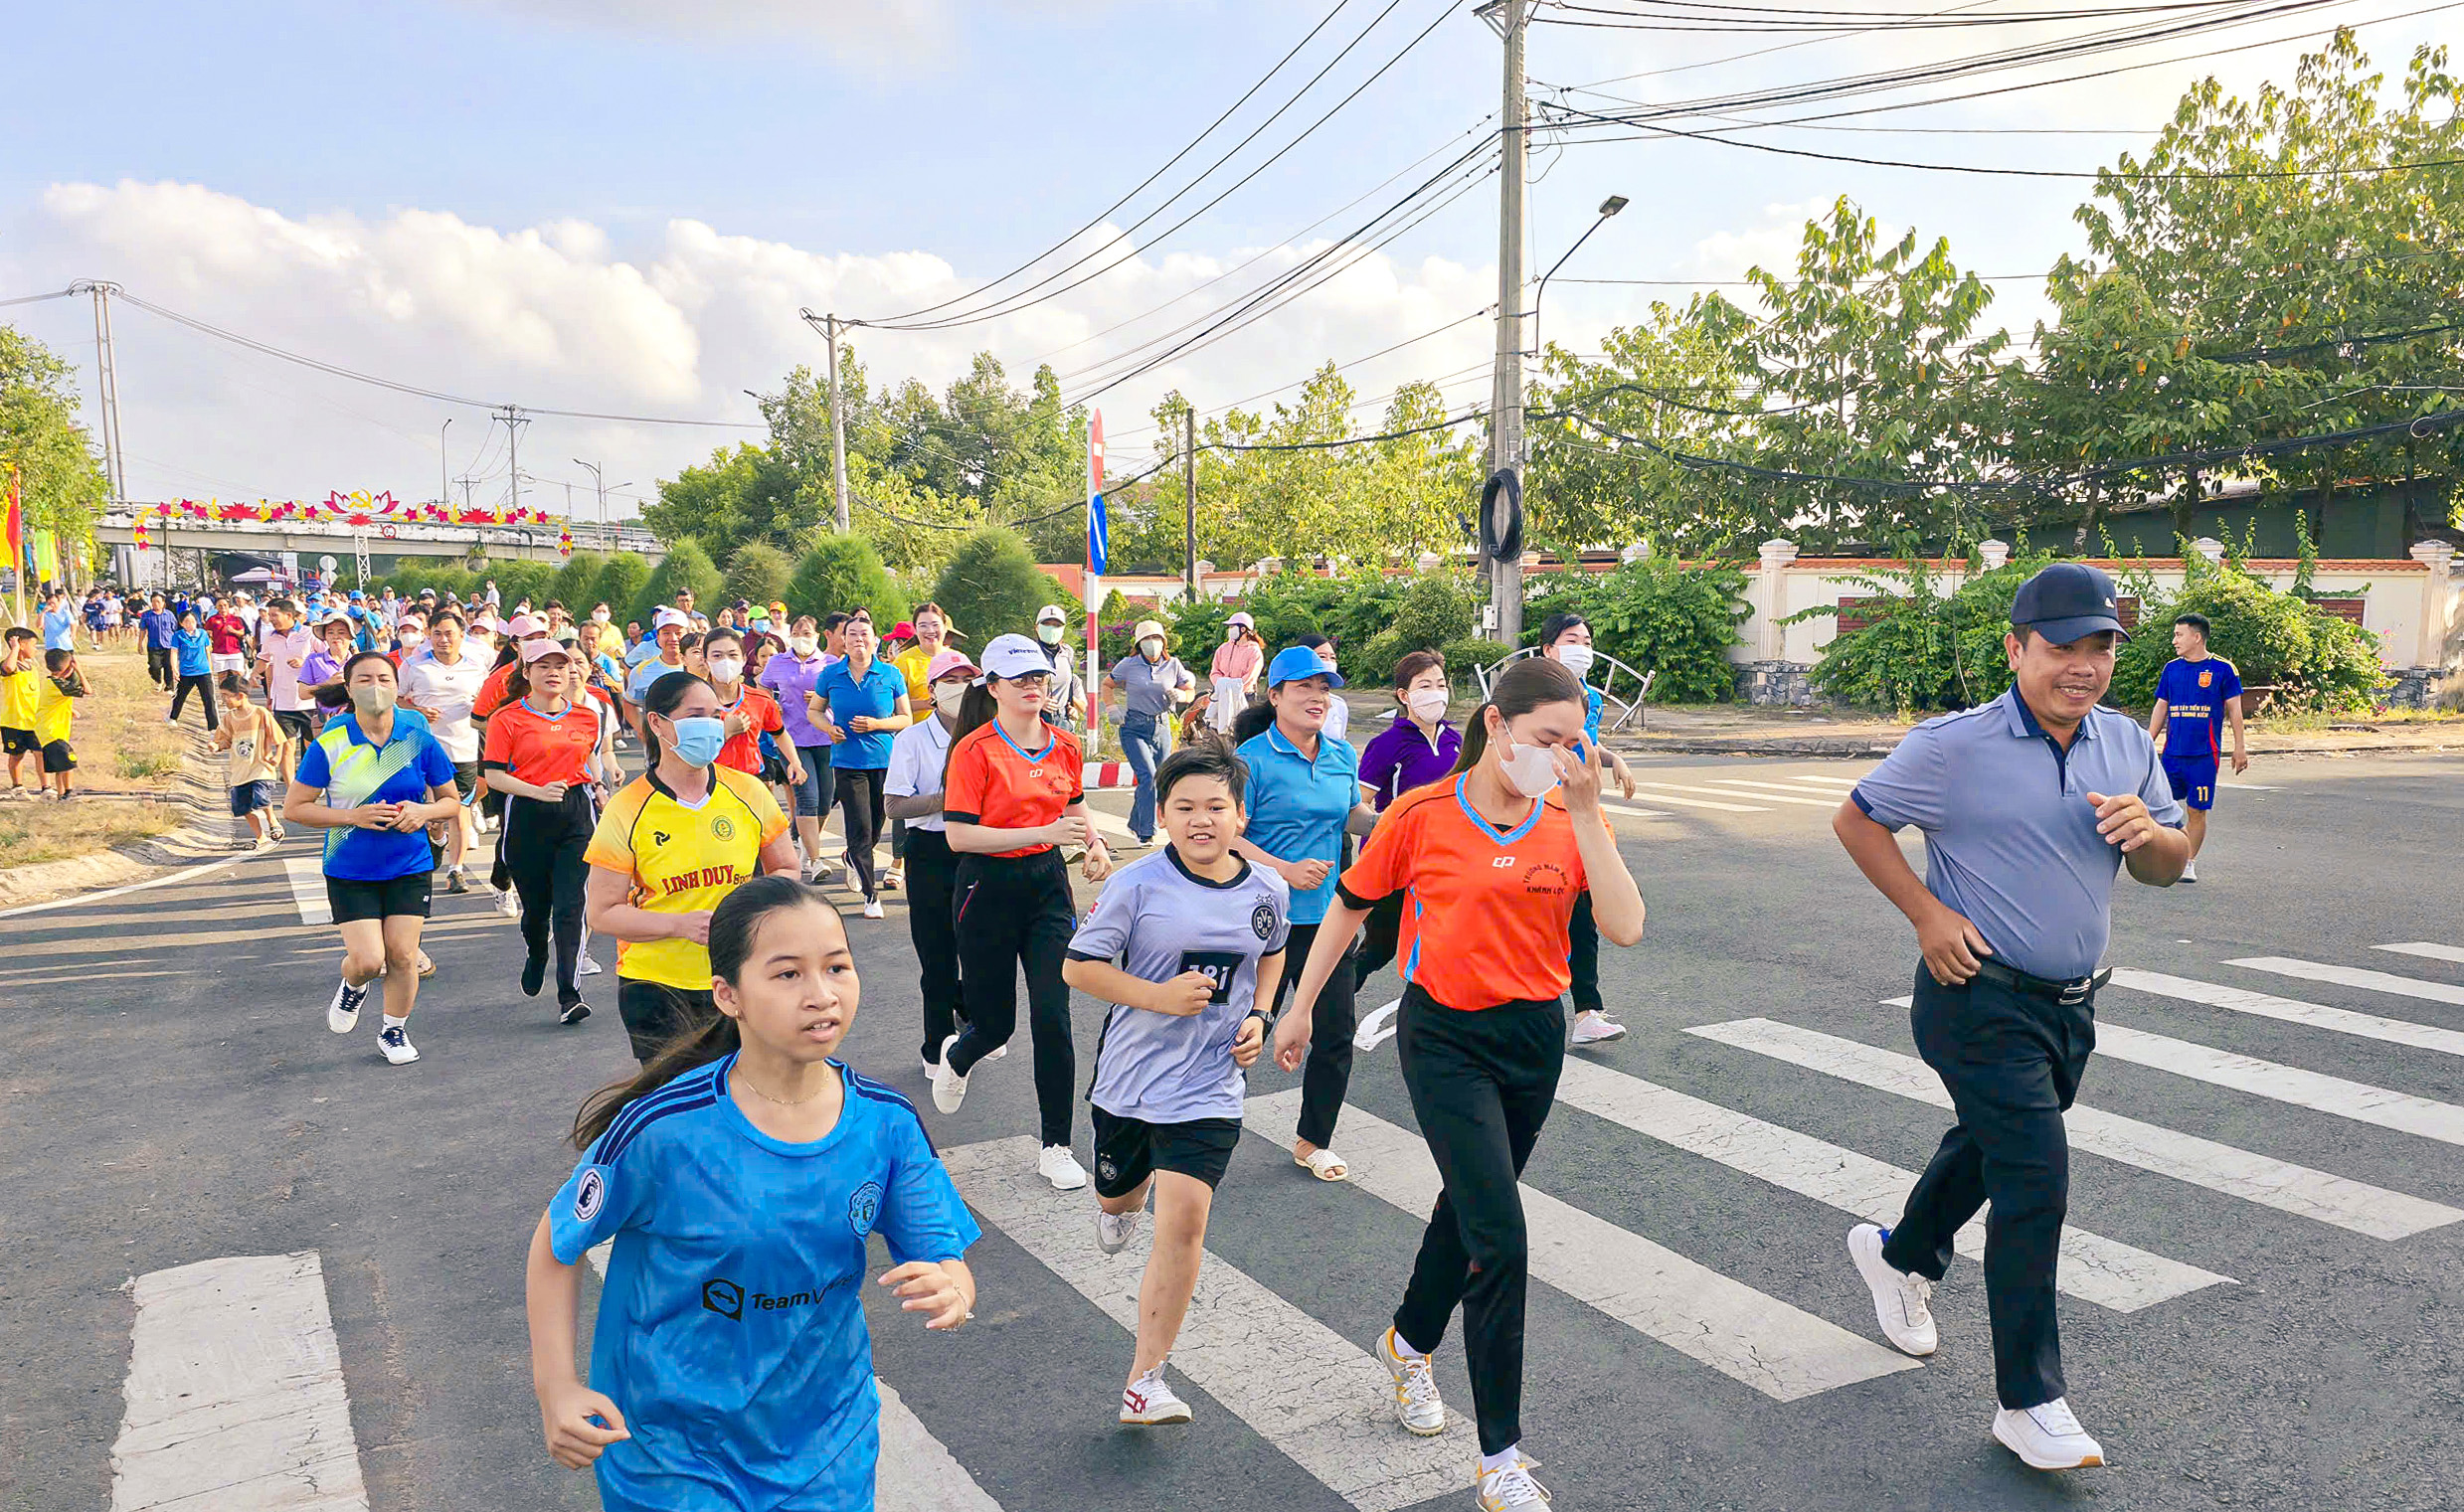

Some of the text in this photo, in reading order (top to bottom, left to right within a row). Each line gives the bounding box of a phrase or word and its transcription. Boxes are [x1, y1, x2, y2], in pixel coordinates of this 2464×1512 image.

[2197, 785, 2208, 801] 11
[661, 871, 699, 896] LINH
[702, 864, 734, 888] DUY
[1256, 910, 1273, 928] BVB
